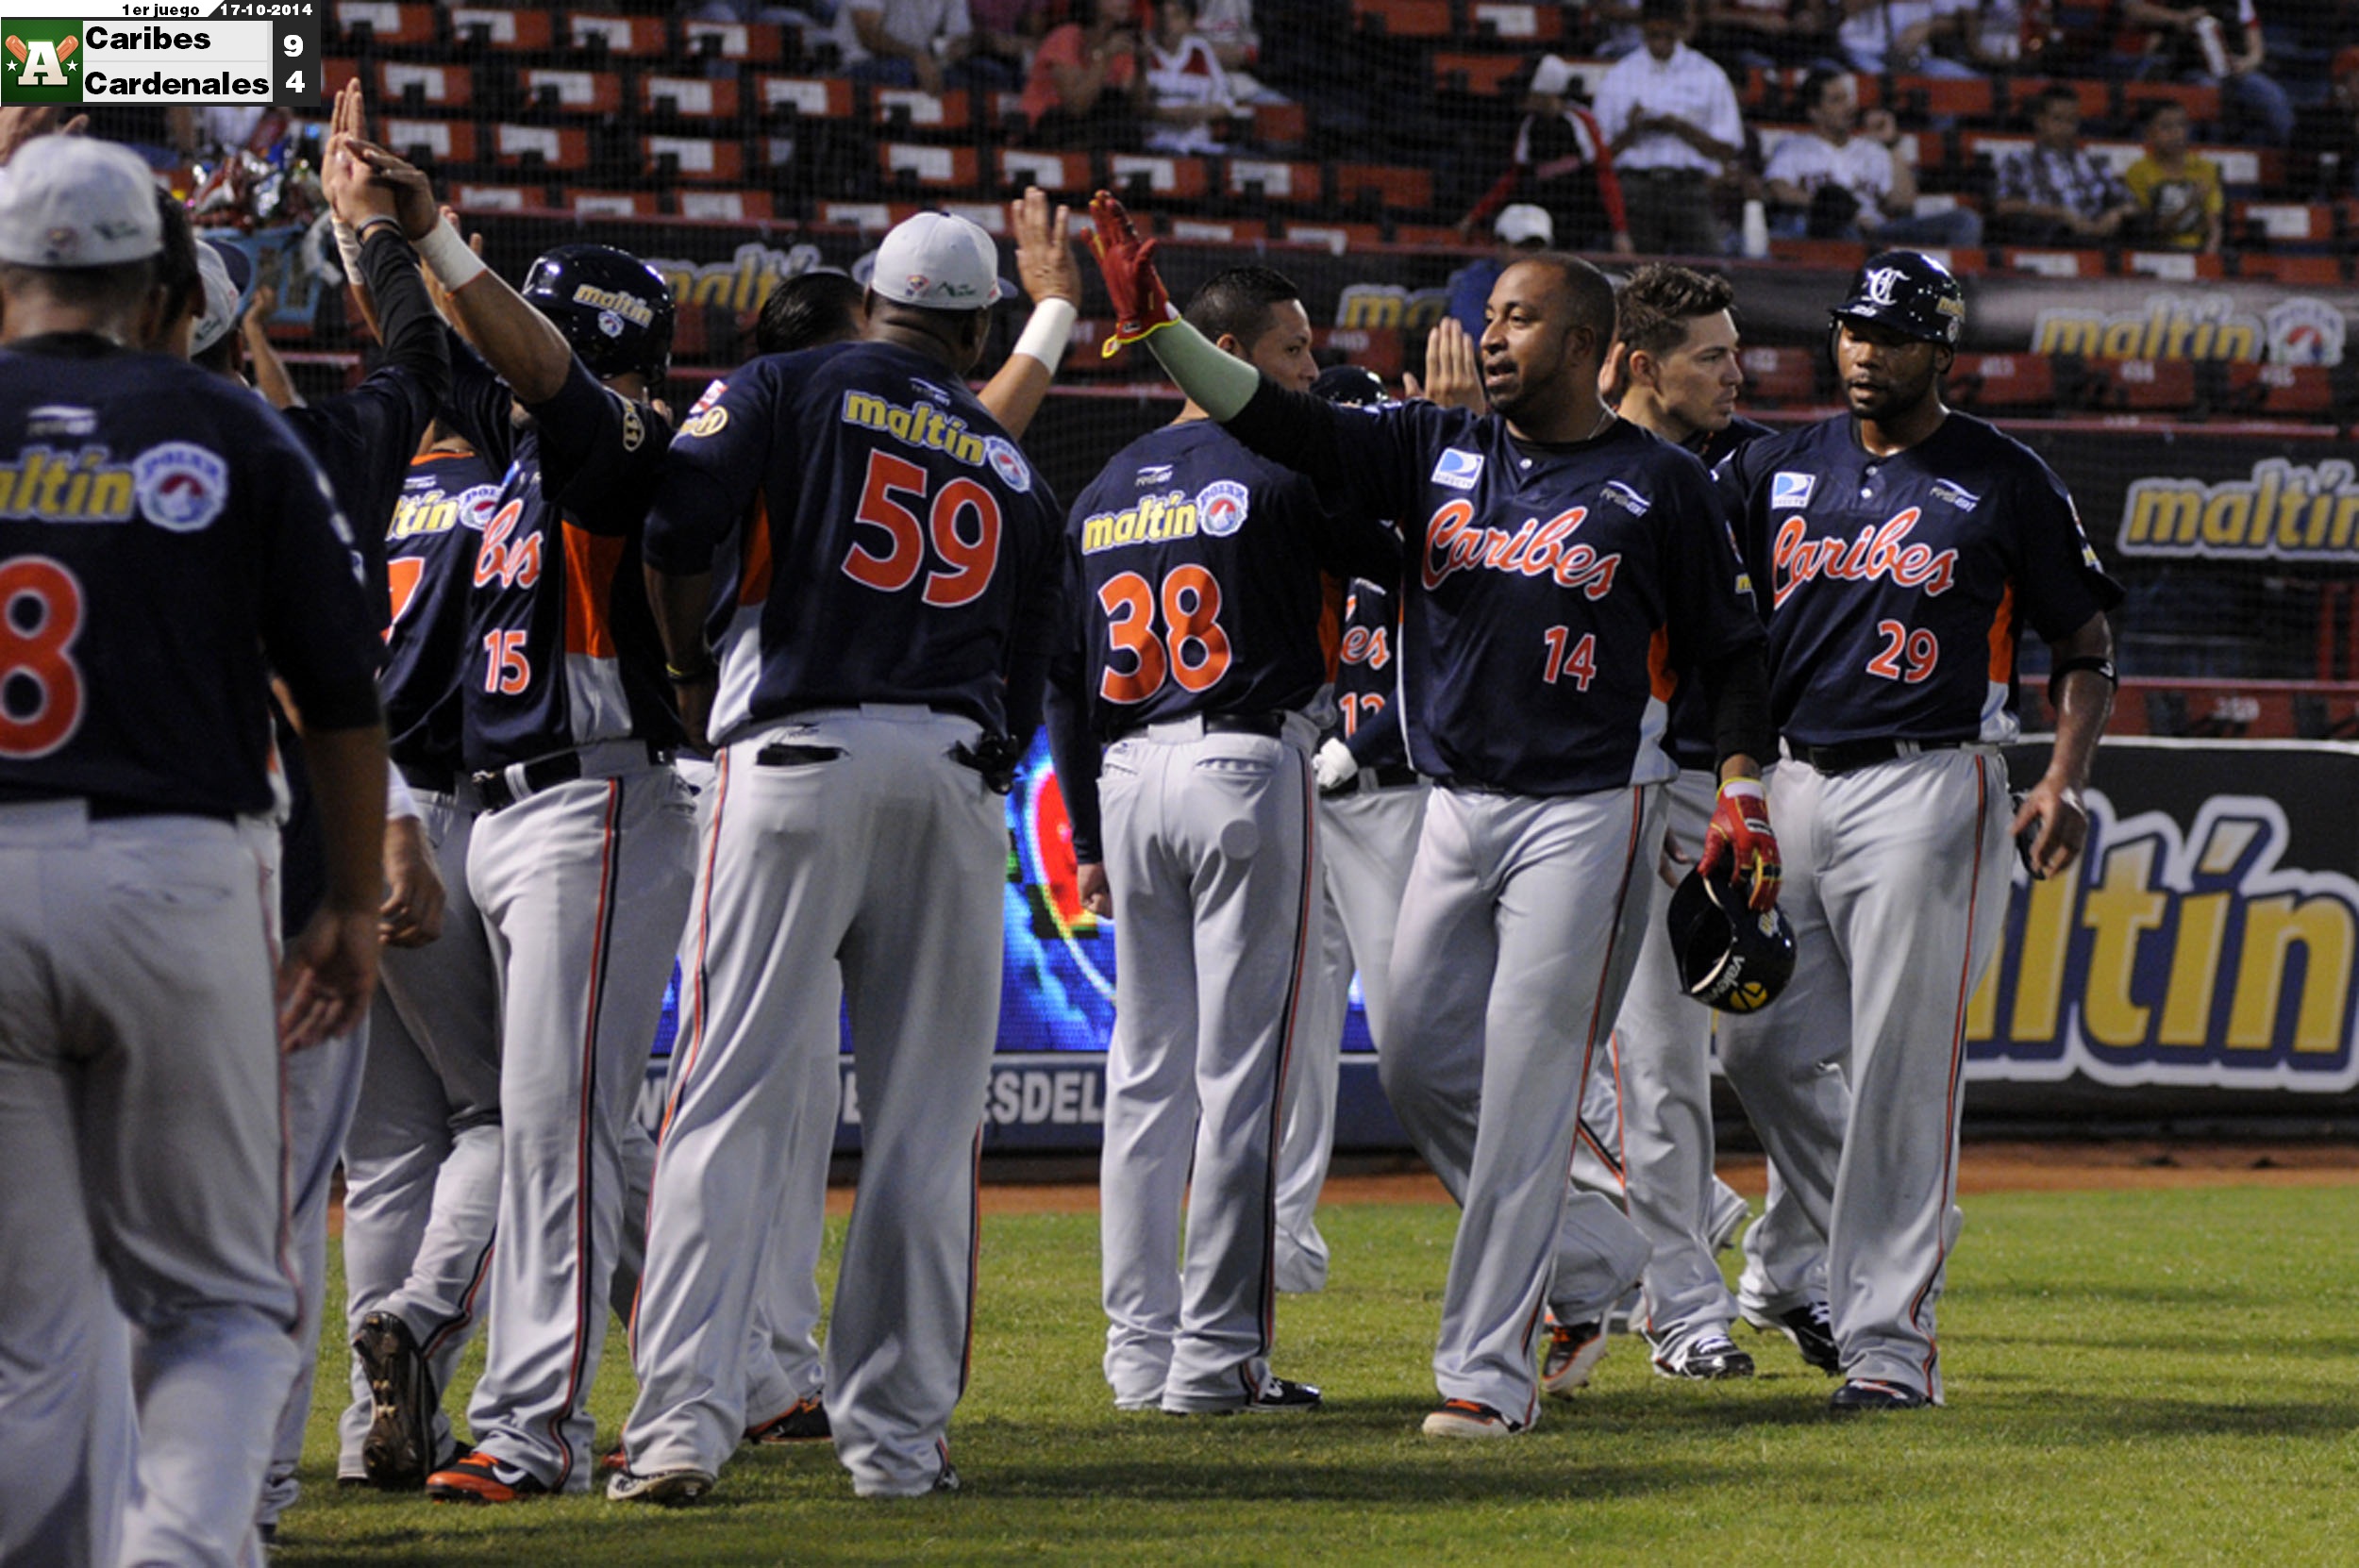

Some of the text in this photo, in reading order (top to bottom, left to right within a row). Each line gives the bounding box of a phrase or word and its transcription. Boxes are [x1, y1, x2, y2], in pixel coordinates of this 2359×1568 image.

[843, 390, 986, 466] maltín
[843, 447, 1002, 607] 59
[1082, 491, 1197, 555] maltín
[1422, 498, 1621, 601] Caribes
[1773, 506, 1958, 610] Caribes
[483, 627, 530, 695] 15
[1098, 564, 1232, 704] 38
[1543, 625, 1597, 692] 14
[1865, 619, 1939, 682] 29
[1967, 795, 2359, 1092] ltín
